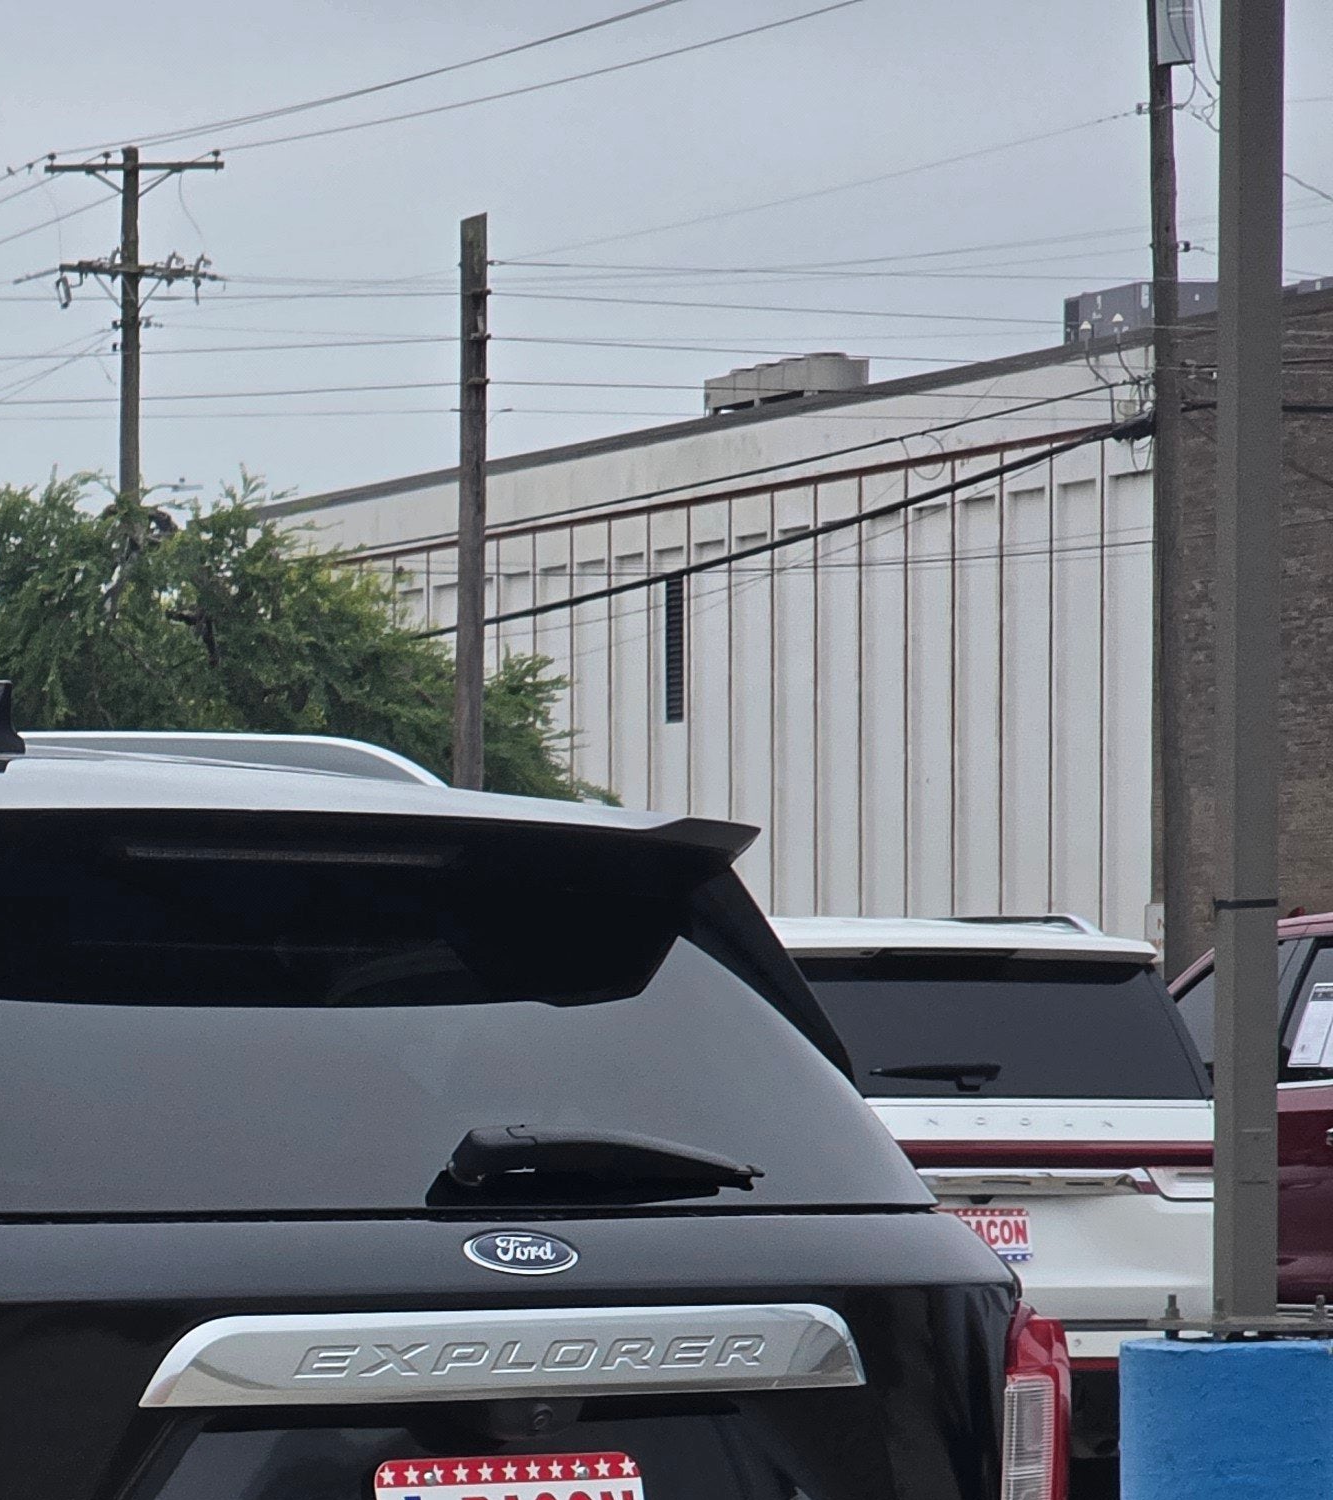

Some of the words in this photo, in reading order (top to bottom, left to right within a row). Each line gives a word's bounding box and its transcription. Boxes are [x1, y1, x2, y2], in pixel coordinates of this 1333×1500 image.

[964, 1219, 1028, 1245] ACON
[495, 1236, 556, 1261] Ford
[292, 1334, 766, 1379] EXPLORER
